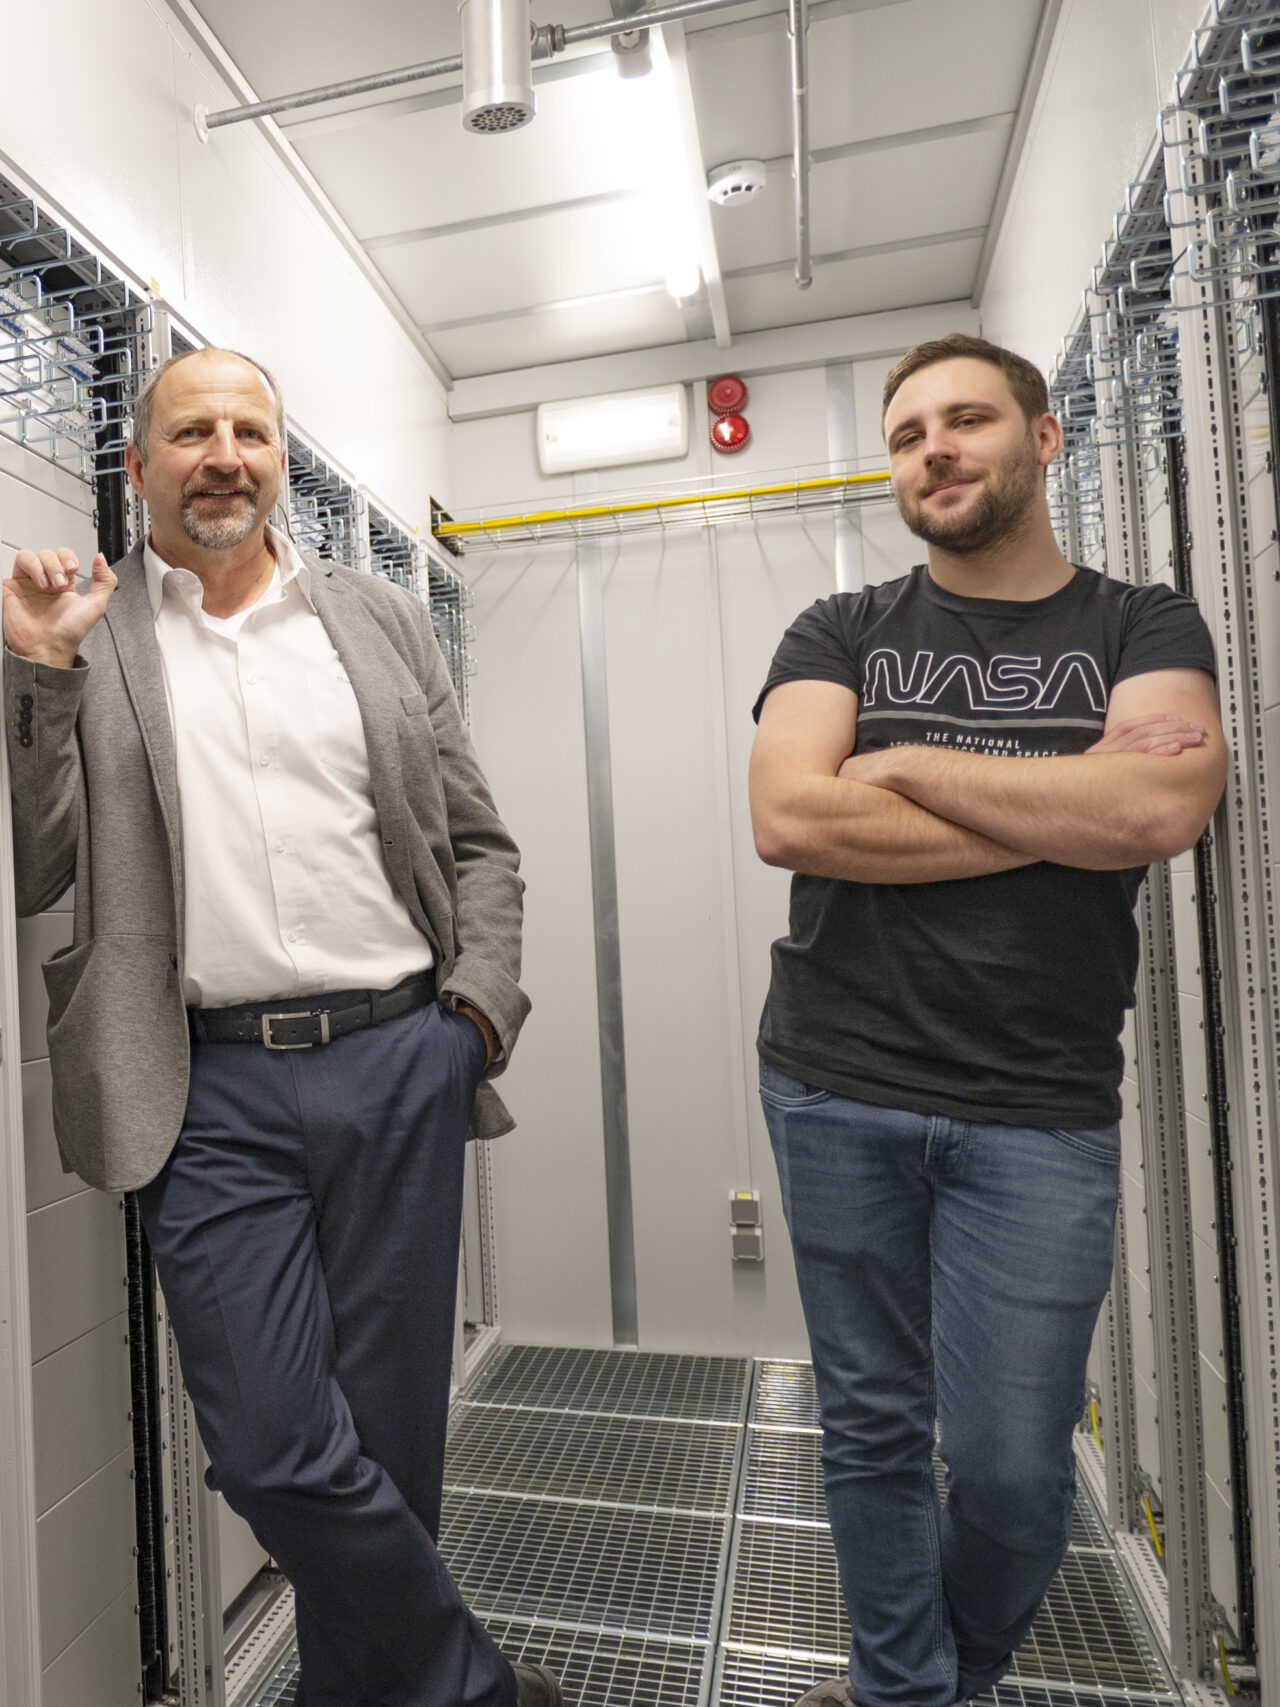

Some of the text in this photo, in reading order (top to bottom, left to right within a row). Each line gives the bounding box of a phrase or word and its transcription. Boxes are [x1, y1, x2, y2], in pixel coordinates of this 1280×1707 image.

[863, 649, 1108, 712] NASA
[926, 732, 949, 743] THE
[956, 734, 1021, 749] NATIONAL
